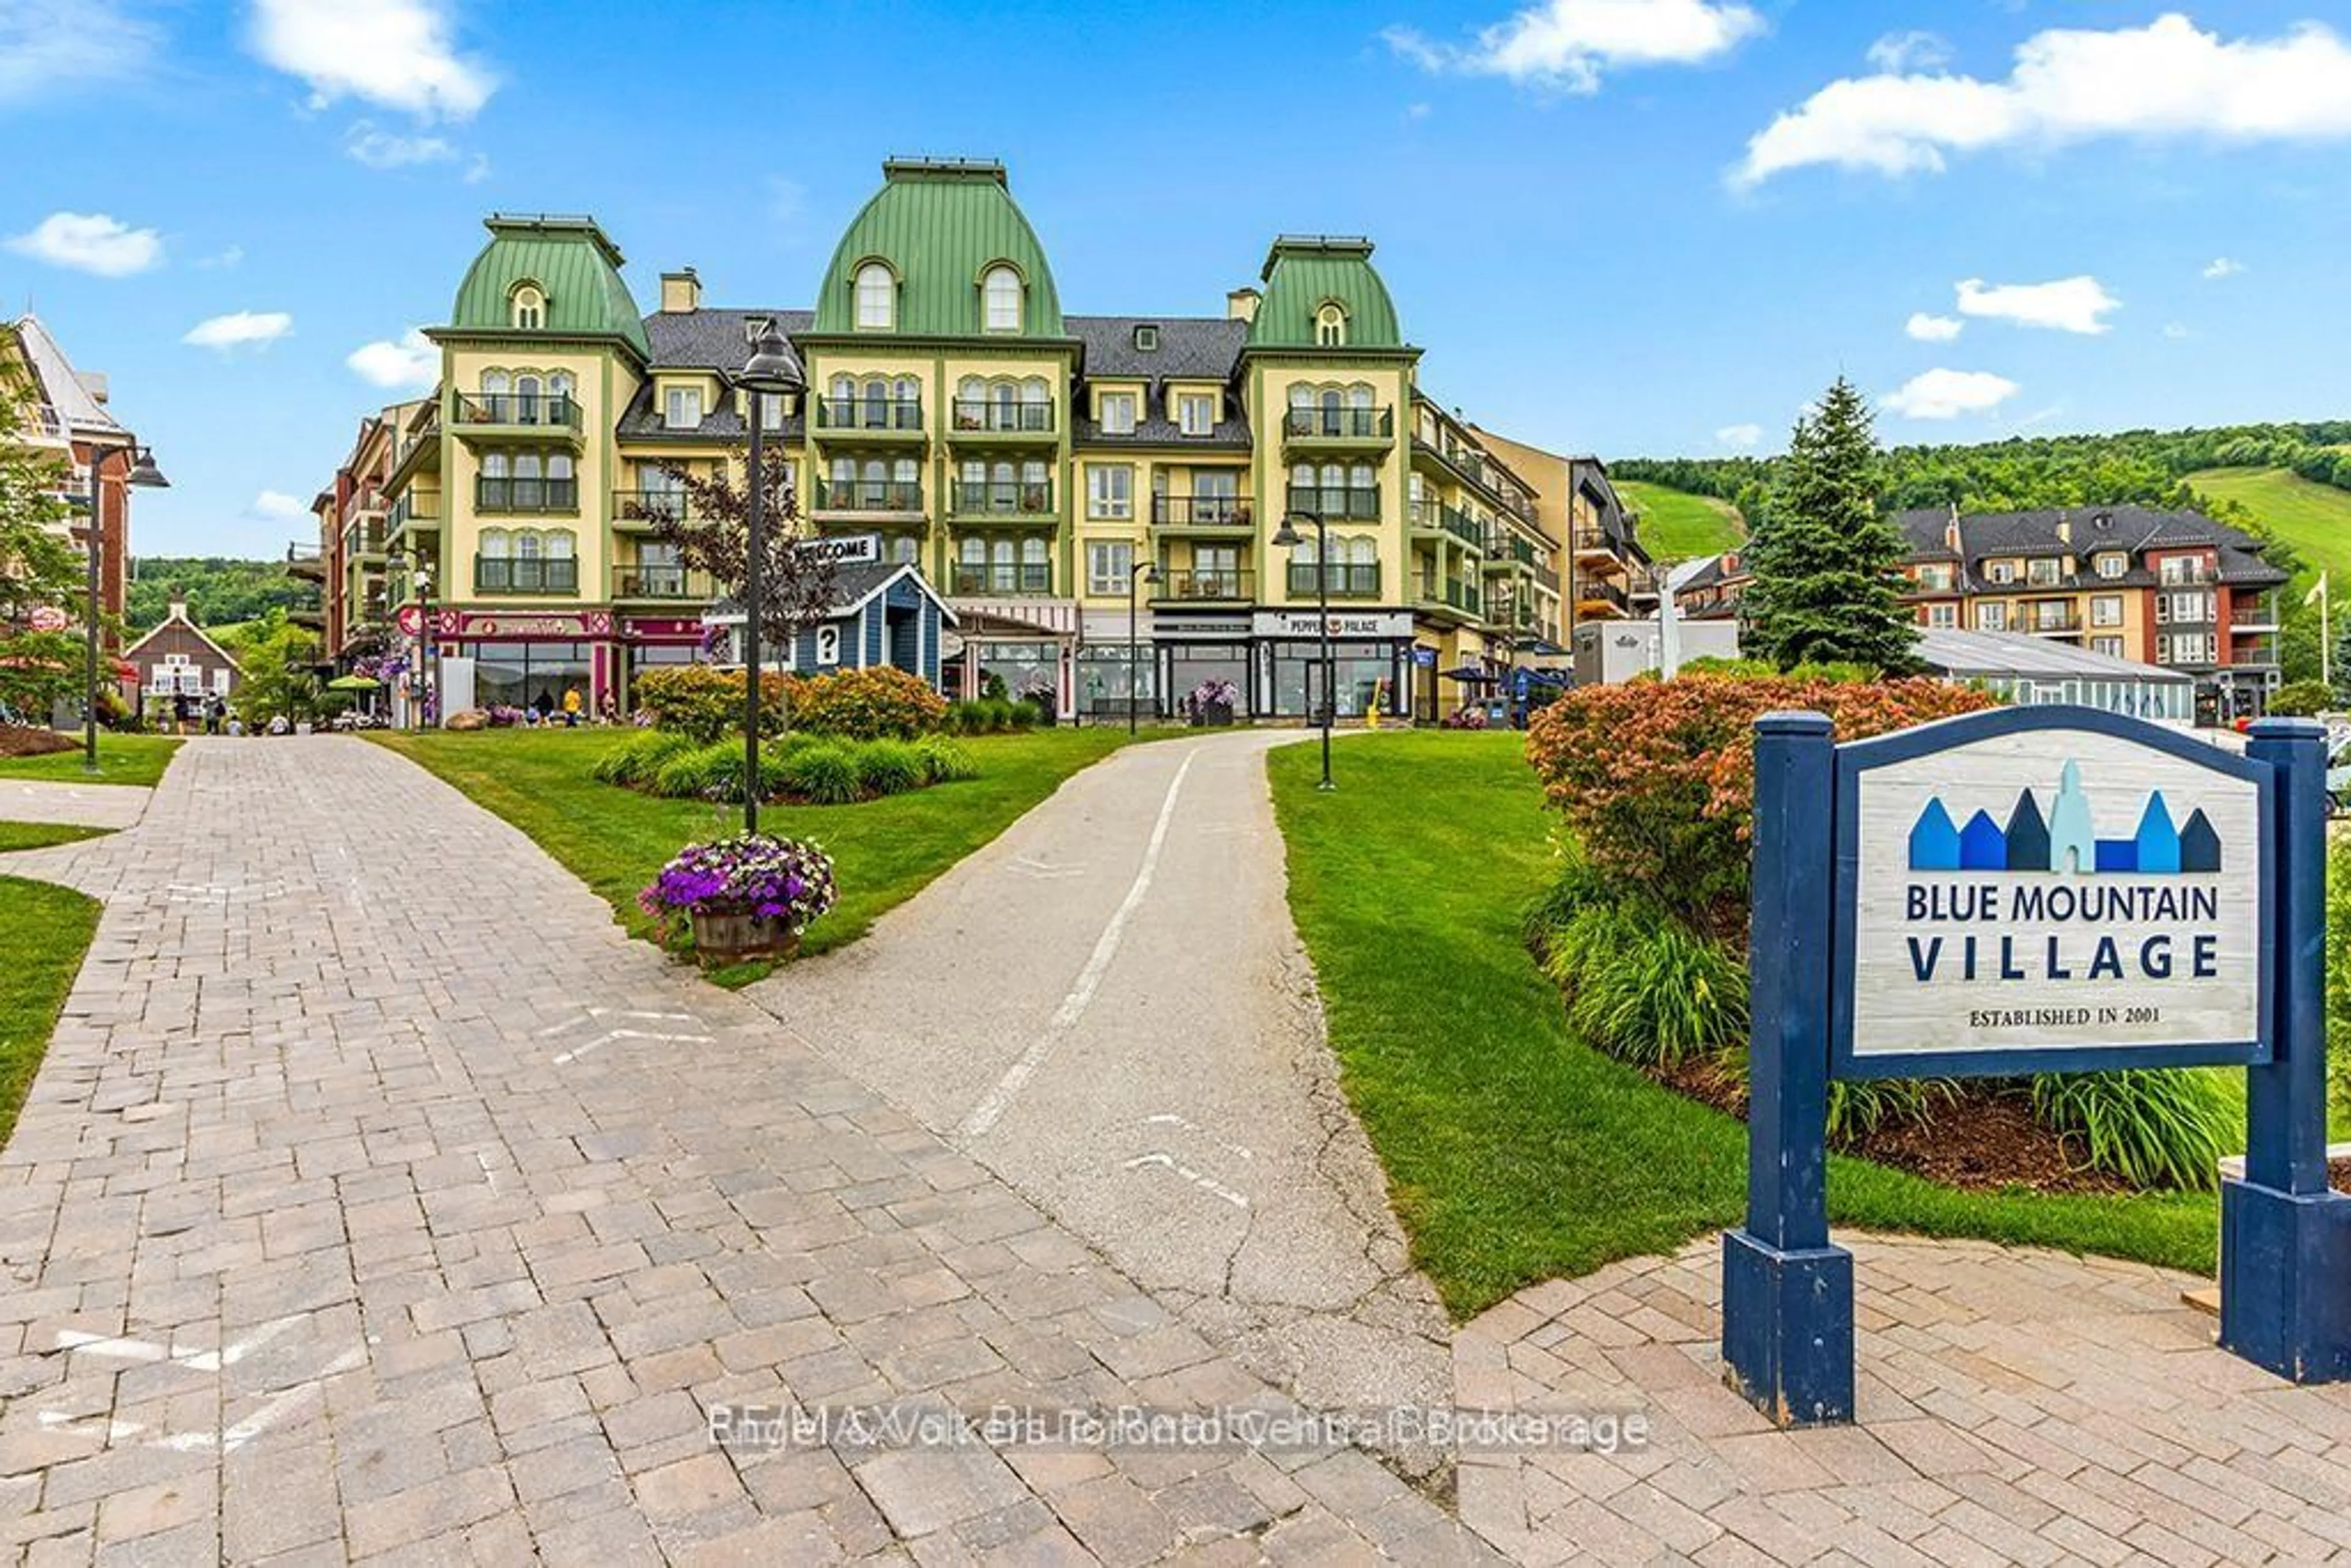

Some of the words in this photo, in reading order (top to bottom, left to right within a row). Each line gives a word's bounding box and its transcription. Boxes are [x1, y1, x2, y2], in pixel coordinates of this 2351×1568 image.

[1291, 620, 1327, 632] PEPPE
[1345, 620, 1378, 632] PALACE
[1907, 884, 1998, 921] BLUE
[2011, 885, 2217, 921] MOUNTAIN
[1907, 935, 2217, 981] VILLAGE
[1970, 1008, 2090, 1027] ESTABLISHED
[2098, 1008, 2117, 1023] IN
[2125, 1007, 2159, 1023] 2001
